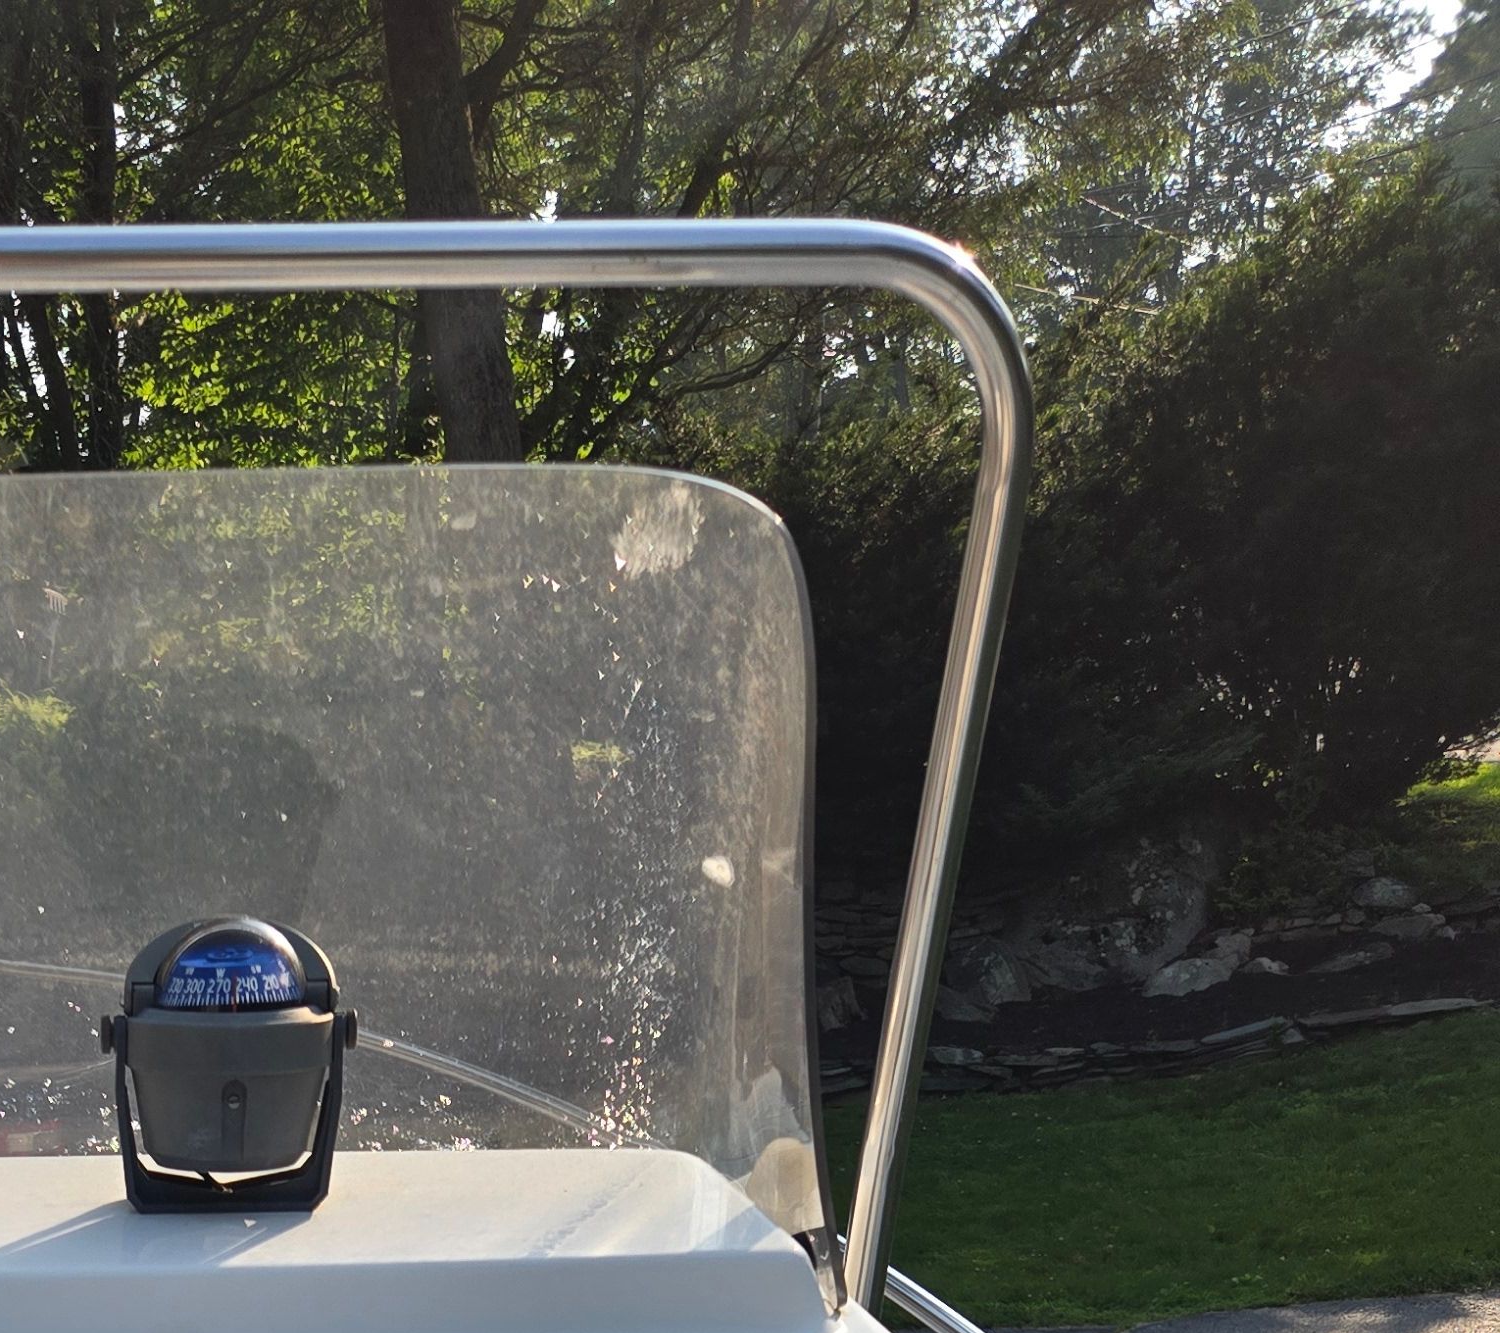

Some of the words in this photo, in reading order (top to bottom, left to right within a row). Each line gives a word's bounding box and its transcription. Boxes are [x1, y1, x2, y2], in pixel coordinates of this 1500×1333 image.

[184, 979, 205, 994] 300
[206, 979, 232, 994] 270
[236, 976, 259, 992] 240
